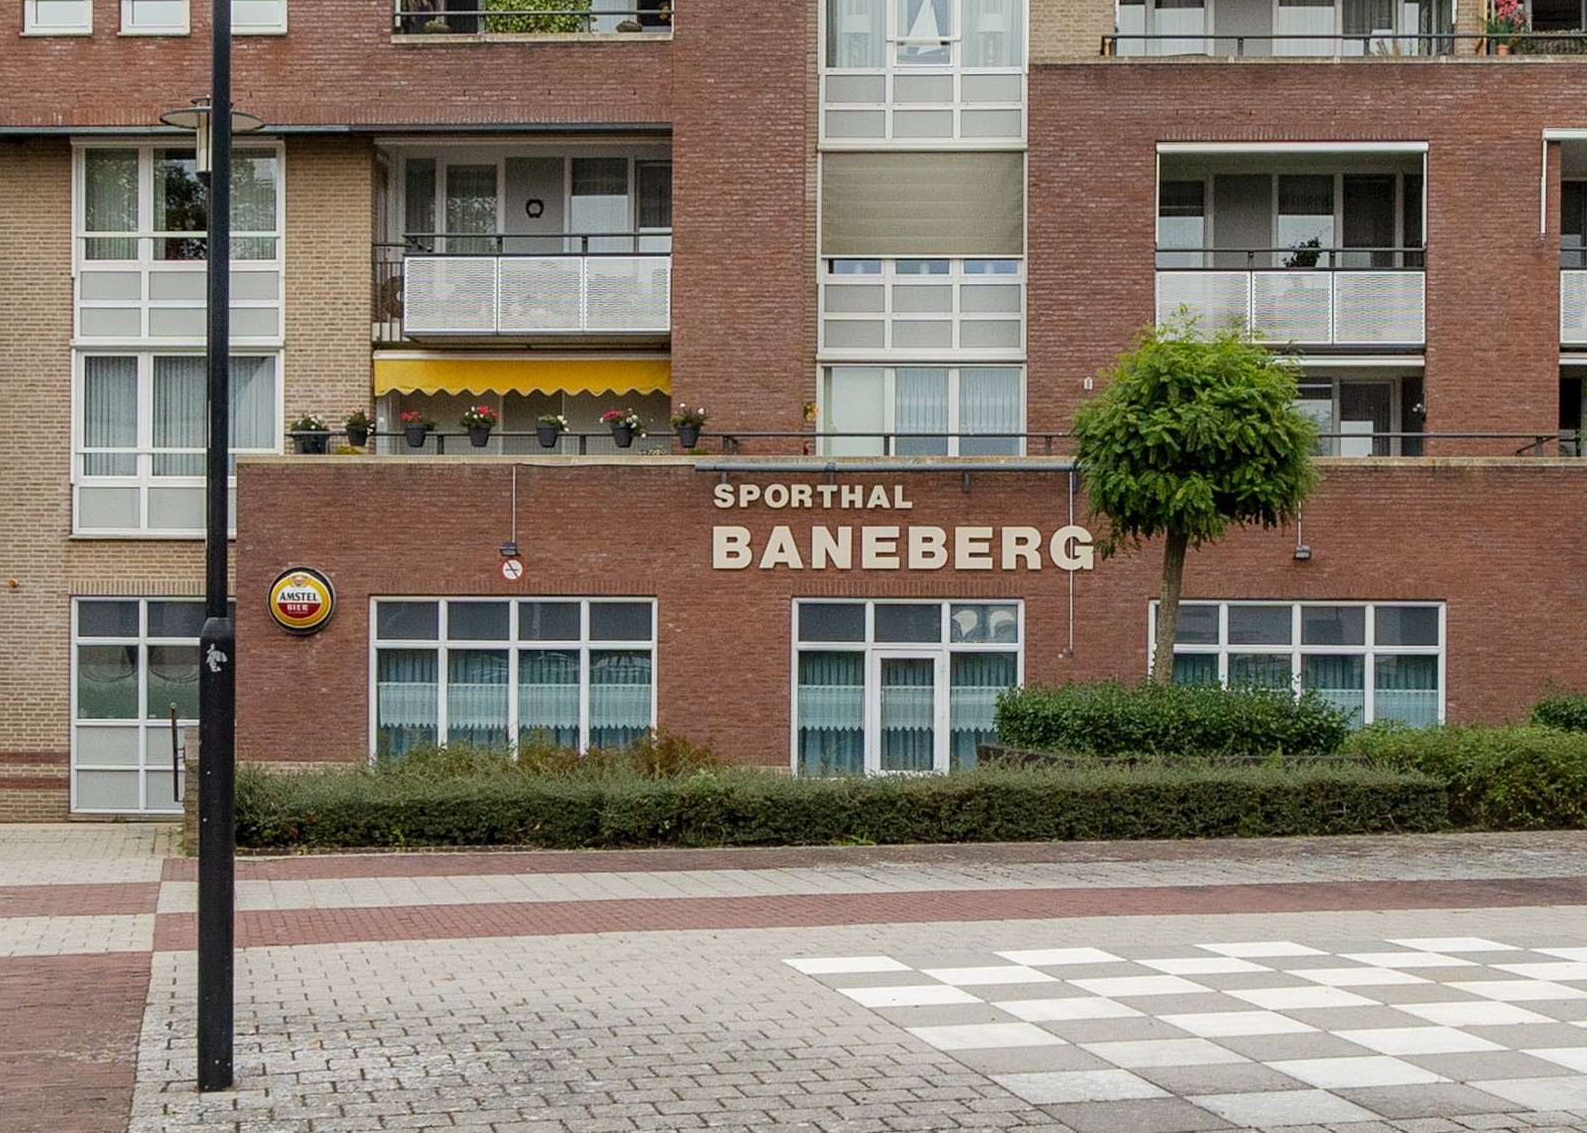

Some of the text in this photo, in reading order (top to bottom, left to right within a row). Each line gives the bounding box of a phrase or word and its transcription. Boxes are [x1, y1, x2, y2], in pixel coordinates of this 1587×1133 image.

[713, 484, 913, 509] SPORTHAL
[712, 525, 1094, 570] BANEBERG
[279, 592, 318, 601] AMSTEL
